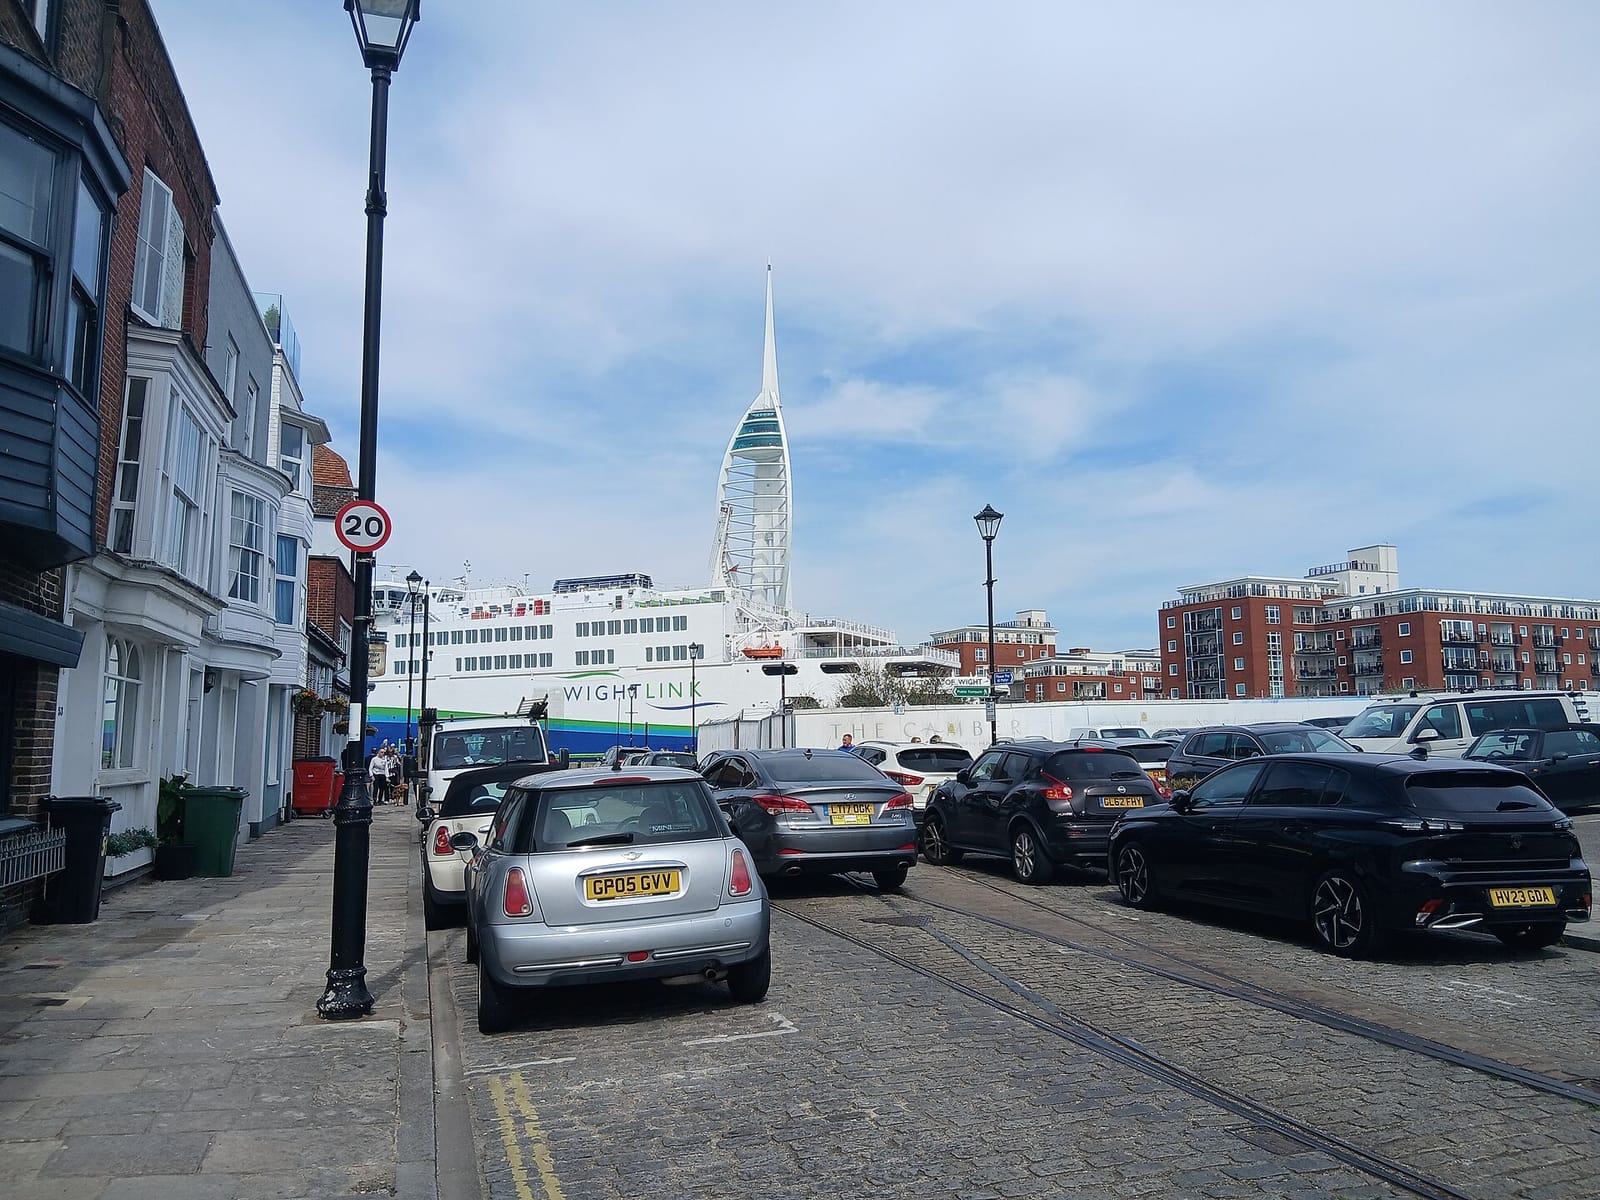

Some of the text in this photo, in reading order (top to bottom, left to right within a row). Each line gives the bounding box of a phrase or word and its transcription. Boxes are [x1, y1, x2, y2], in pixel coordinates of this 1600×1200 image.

[344, 514, 383, 538] 20
[958, 678, 983, 686] WIGHT
[829, 722, 885, 739] THE
[831, 804, 851, 814] LT17
[1103, 797, 1142, 807] GL62 FHY
[593, 873, 671, 896] GP05 GVV
[1495, 889, 1549, 904] HV23 GDA
